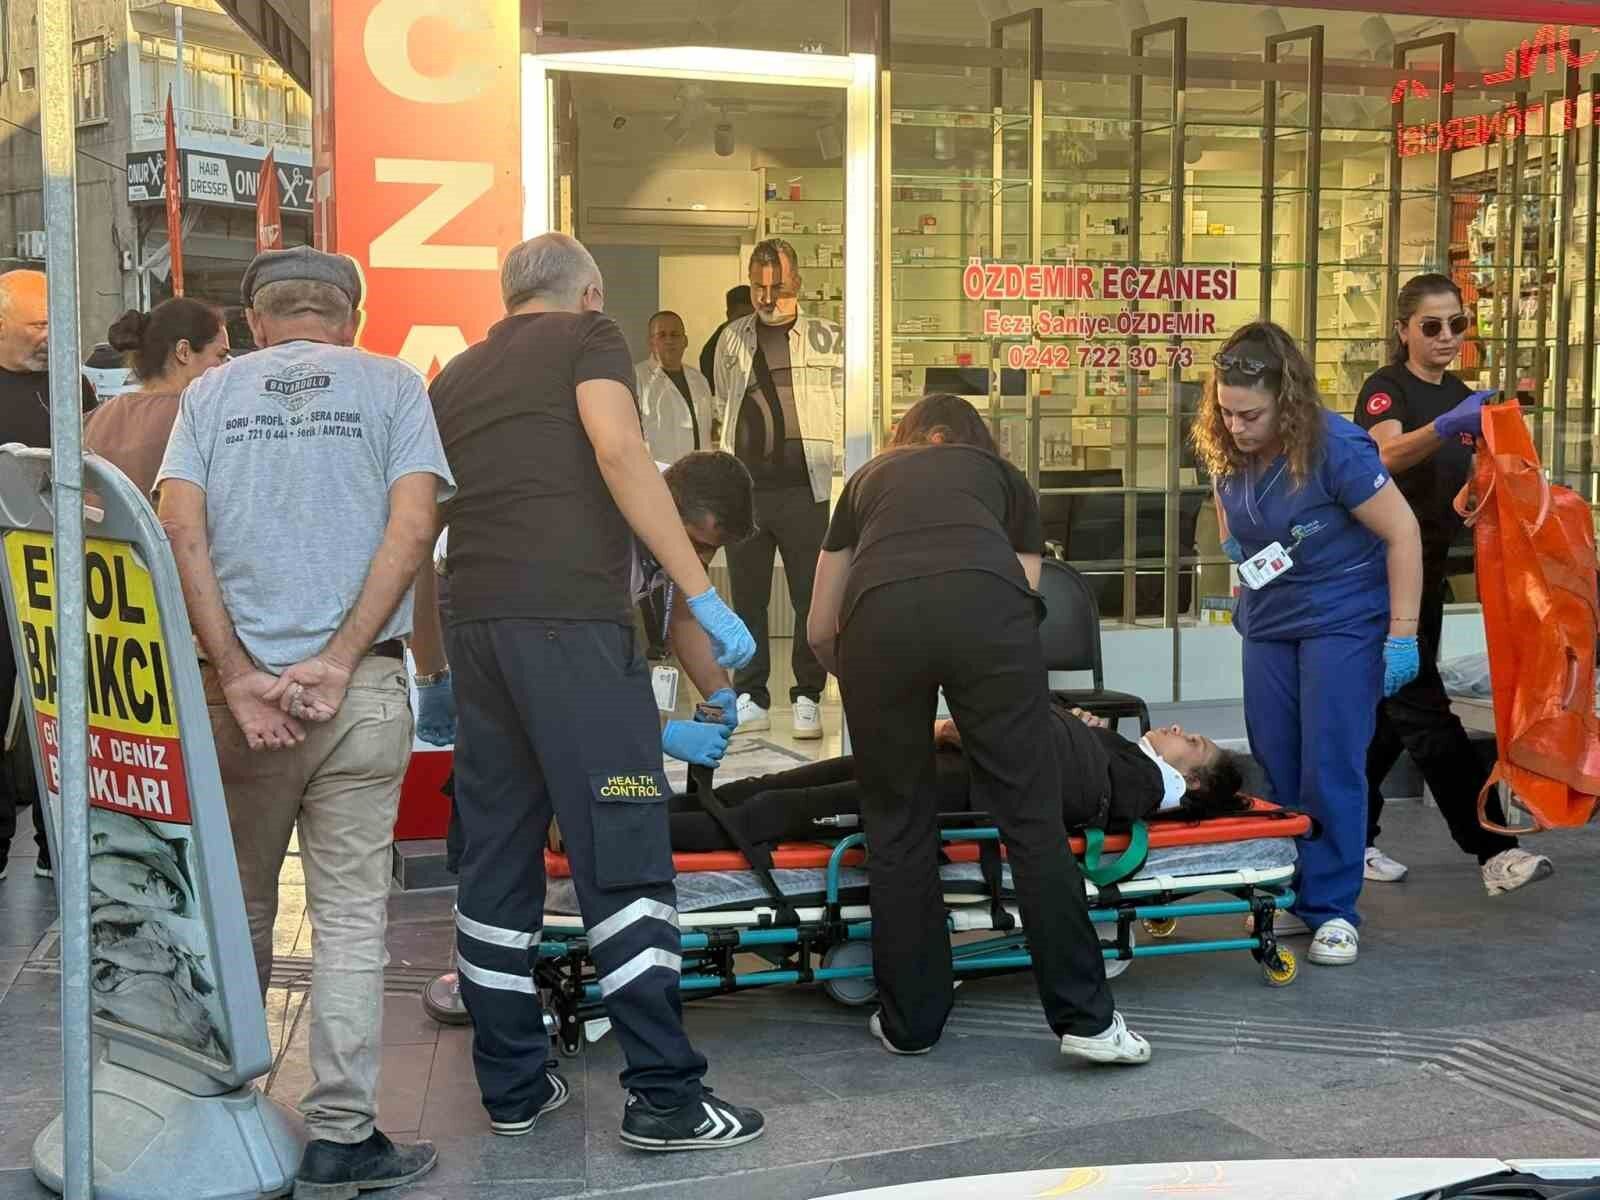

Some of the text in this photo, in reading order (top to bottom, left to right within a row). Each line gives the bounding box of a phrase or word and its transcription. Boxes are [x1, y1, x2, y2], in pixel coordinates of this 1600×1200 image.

[127, 163, 150, 184] ONUR
[198, 160, 220, 176] HAIR
[190, 178, 228, 197] DRESSER
[963, 258, 1238, 300] ÖZDEMİR ECZANESİ
[1038, 311, 1110, 338] Saniye
[1117, 308, 1216, 334] ÖZDEMİR
[1008, 345, 1193, 368] 0242 722 30 73
[225, 416, 249, 430] BORU
[255, 413, 284, 426] PROFİL
[310, 410, 331, 423] SERA
[334, 409, 361, 423] DEMİR
[225, 434, 245, 445] 0242
[247, 429, 263, 440] 721
[265, 429, 271, 440] 0
[322, 424, 362, 439] ANTALYA
[23, 544, 146, 624] EOL
[22, 621, 172, 726] BAIKCI
[110, 738, 169, 770] DENİZ
[48, 753, 173, 815] BIKLARI
[600, 785, 662, 797] CONTROL
[607, 775, 653, 786] HEALTH
